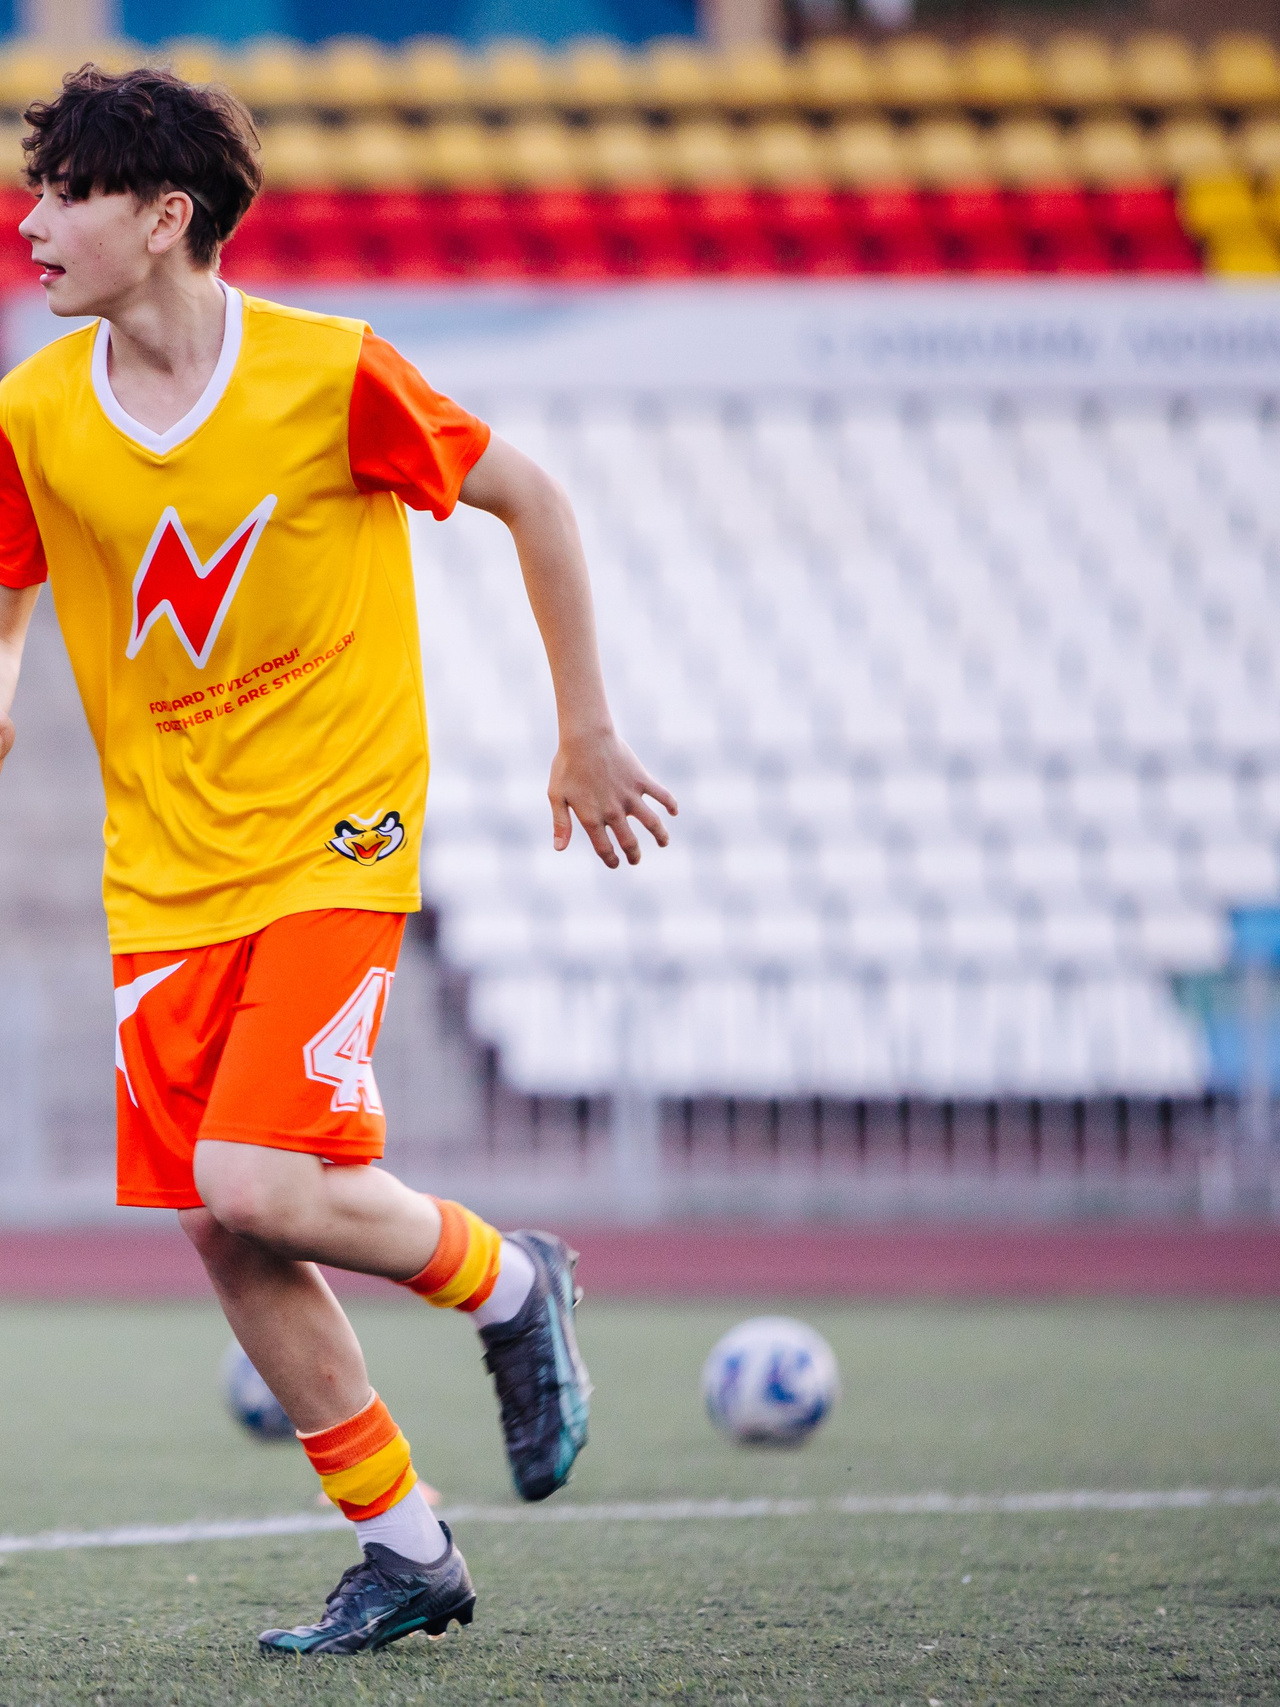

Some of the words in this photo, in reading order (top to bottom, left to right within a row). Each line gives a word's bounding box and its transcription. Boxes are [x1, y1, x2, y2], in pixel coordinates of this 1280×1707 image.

[149, 691, 205, 714] FORARD
[206, 683, 225, 697] TO
[226, 648, 300, 692] VICTORY!
[237, 683, 271, 707] ARE
[272, 631, 356, 690] STRONGER!
